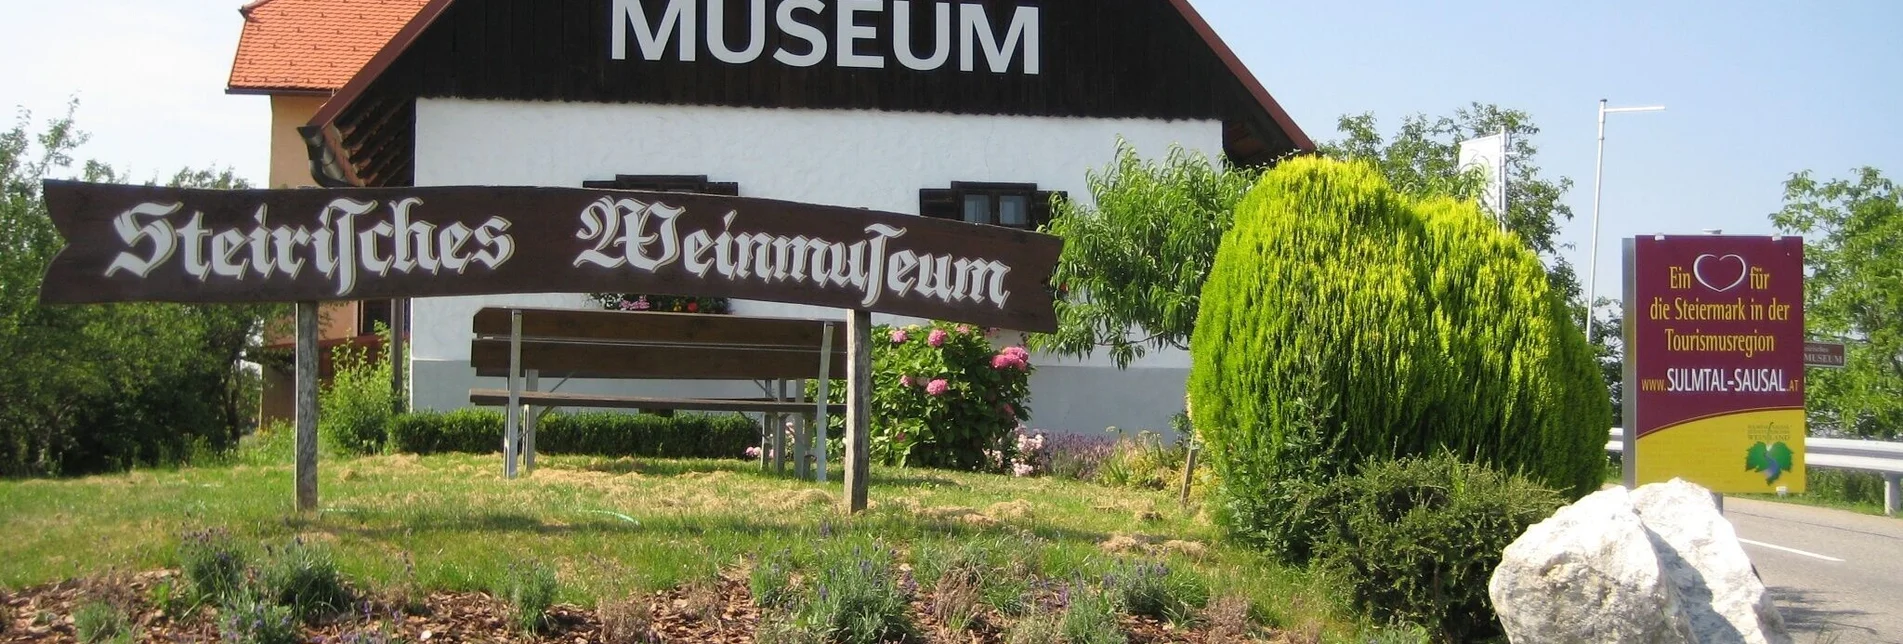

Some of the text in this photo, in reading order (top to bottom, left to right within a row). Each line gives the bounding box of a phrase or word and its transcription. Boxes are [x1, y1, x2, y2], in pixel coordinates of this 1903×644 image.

[611, 0, 1040, 75] MUSEUM
[1669, 266, 1770, 290] Ein für
[1650, 297, 1790, 321] die Steiermark in der
[1665, 328, 1775, 358] Tourismusregion
